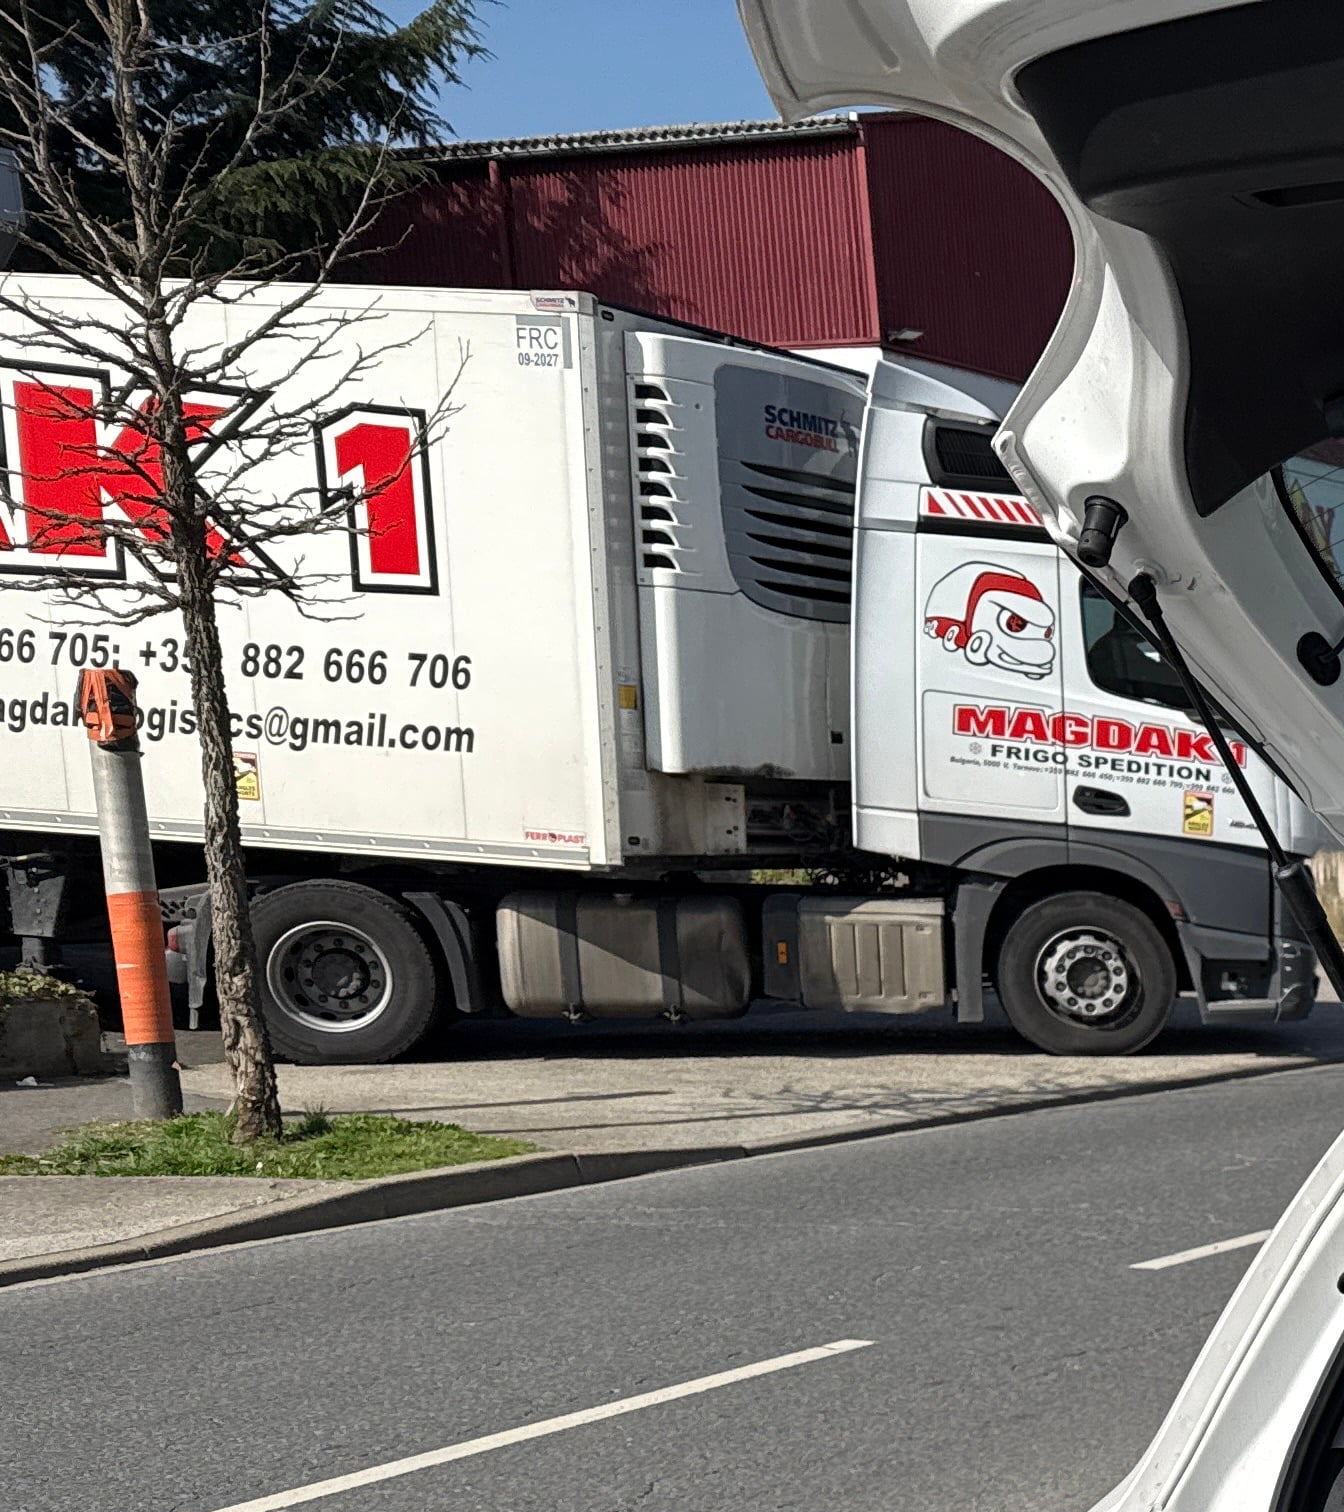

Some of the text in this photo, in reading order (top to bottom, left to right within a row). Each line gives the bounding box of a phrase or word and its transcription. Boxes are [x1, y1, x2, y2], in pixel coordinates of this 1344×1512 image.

[516, 328, 558, 350] FRC
[518, 352, 559, 367] 09-2027
[764, 405, 839, 438] SCHMITZ
[765, 424, 840, 453] CARGOBULL
[315, 402, 440, 596] 1
[241, 642, 305, 680] 882
[323, 647, 388, 685] 666
[407, 651, 473, 690] 706
[952, 703, 1224, 768] MAGDAK
[990, 744, 1212, 782] FRIGO SPEDITION
